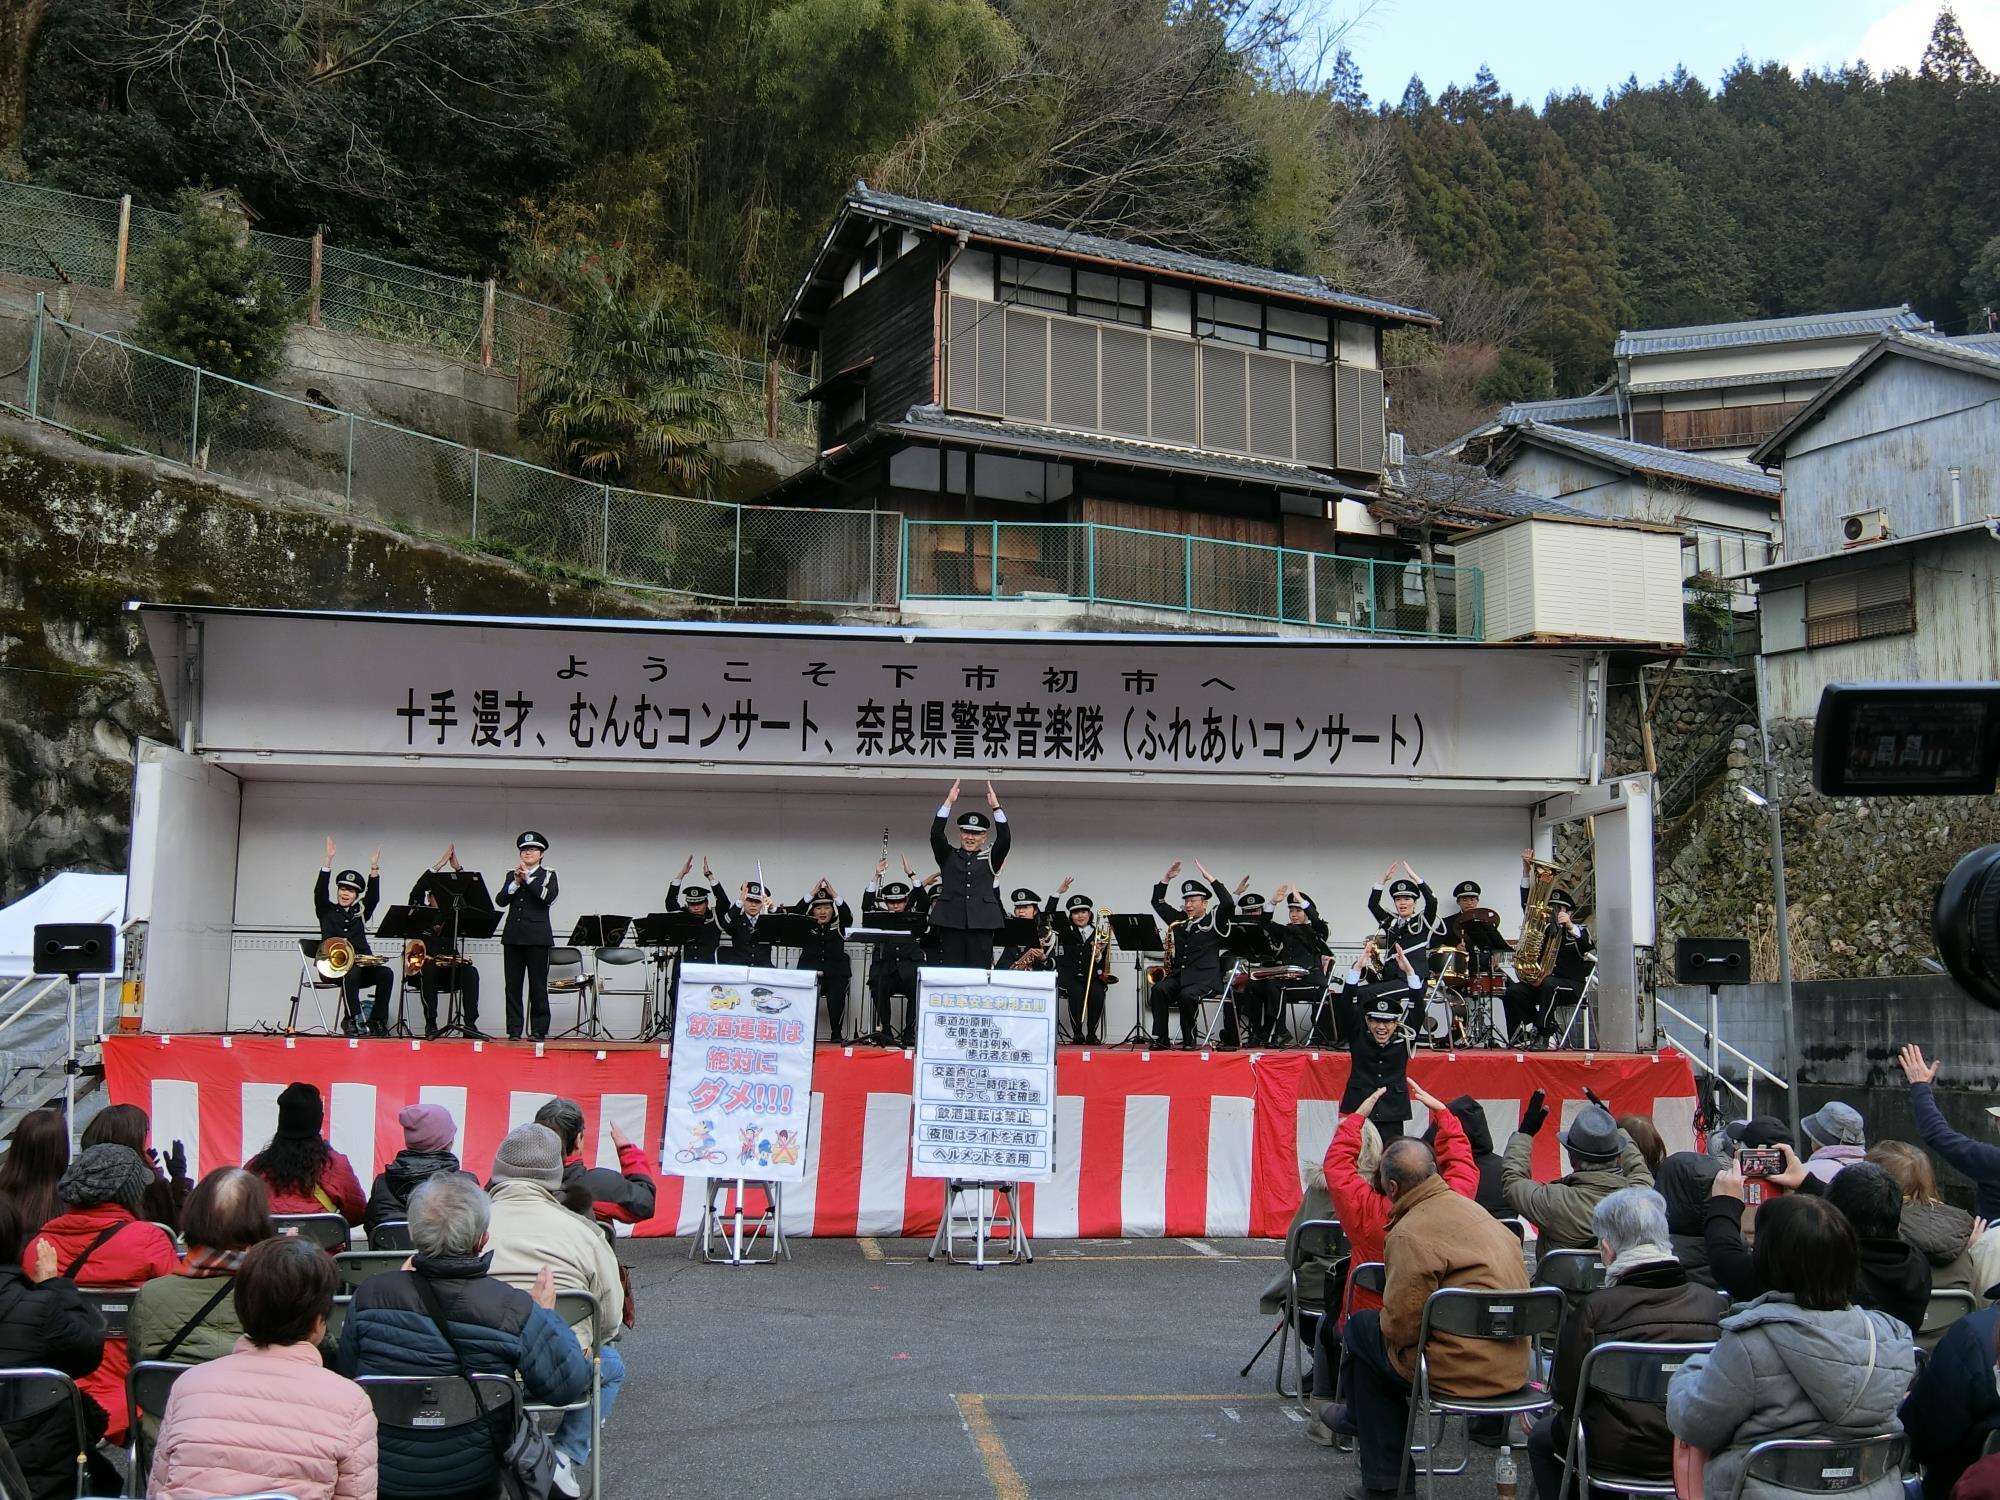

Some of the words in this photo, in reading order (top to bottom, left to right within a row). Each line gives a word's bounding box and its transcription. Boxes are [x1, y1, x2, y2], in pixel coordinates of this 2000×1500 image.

[557, 655, 1236, 696] ようこそ下市初市へ
[687, 1013, 804, 1043] 飲酒運転は
[946, 1027, 1001, 1039] 左側を通行
[706, 1046, 778, 1074] 絶対に
[967, 1049, 1032, 1062] 歩行者を優先
[944, 1078, 1030, 1091] 信号と一時停止を
[936, 1106, 1031, 1125] 飲酒運転は禁止
[928, 1127, 1038, 1145] 夜間はライトを点灯
[933, 1148, 1031, 1167] ヘルメットを着用
